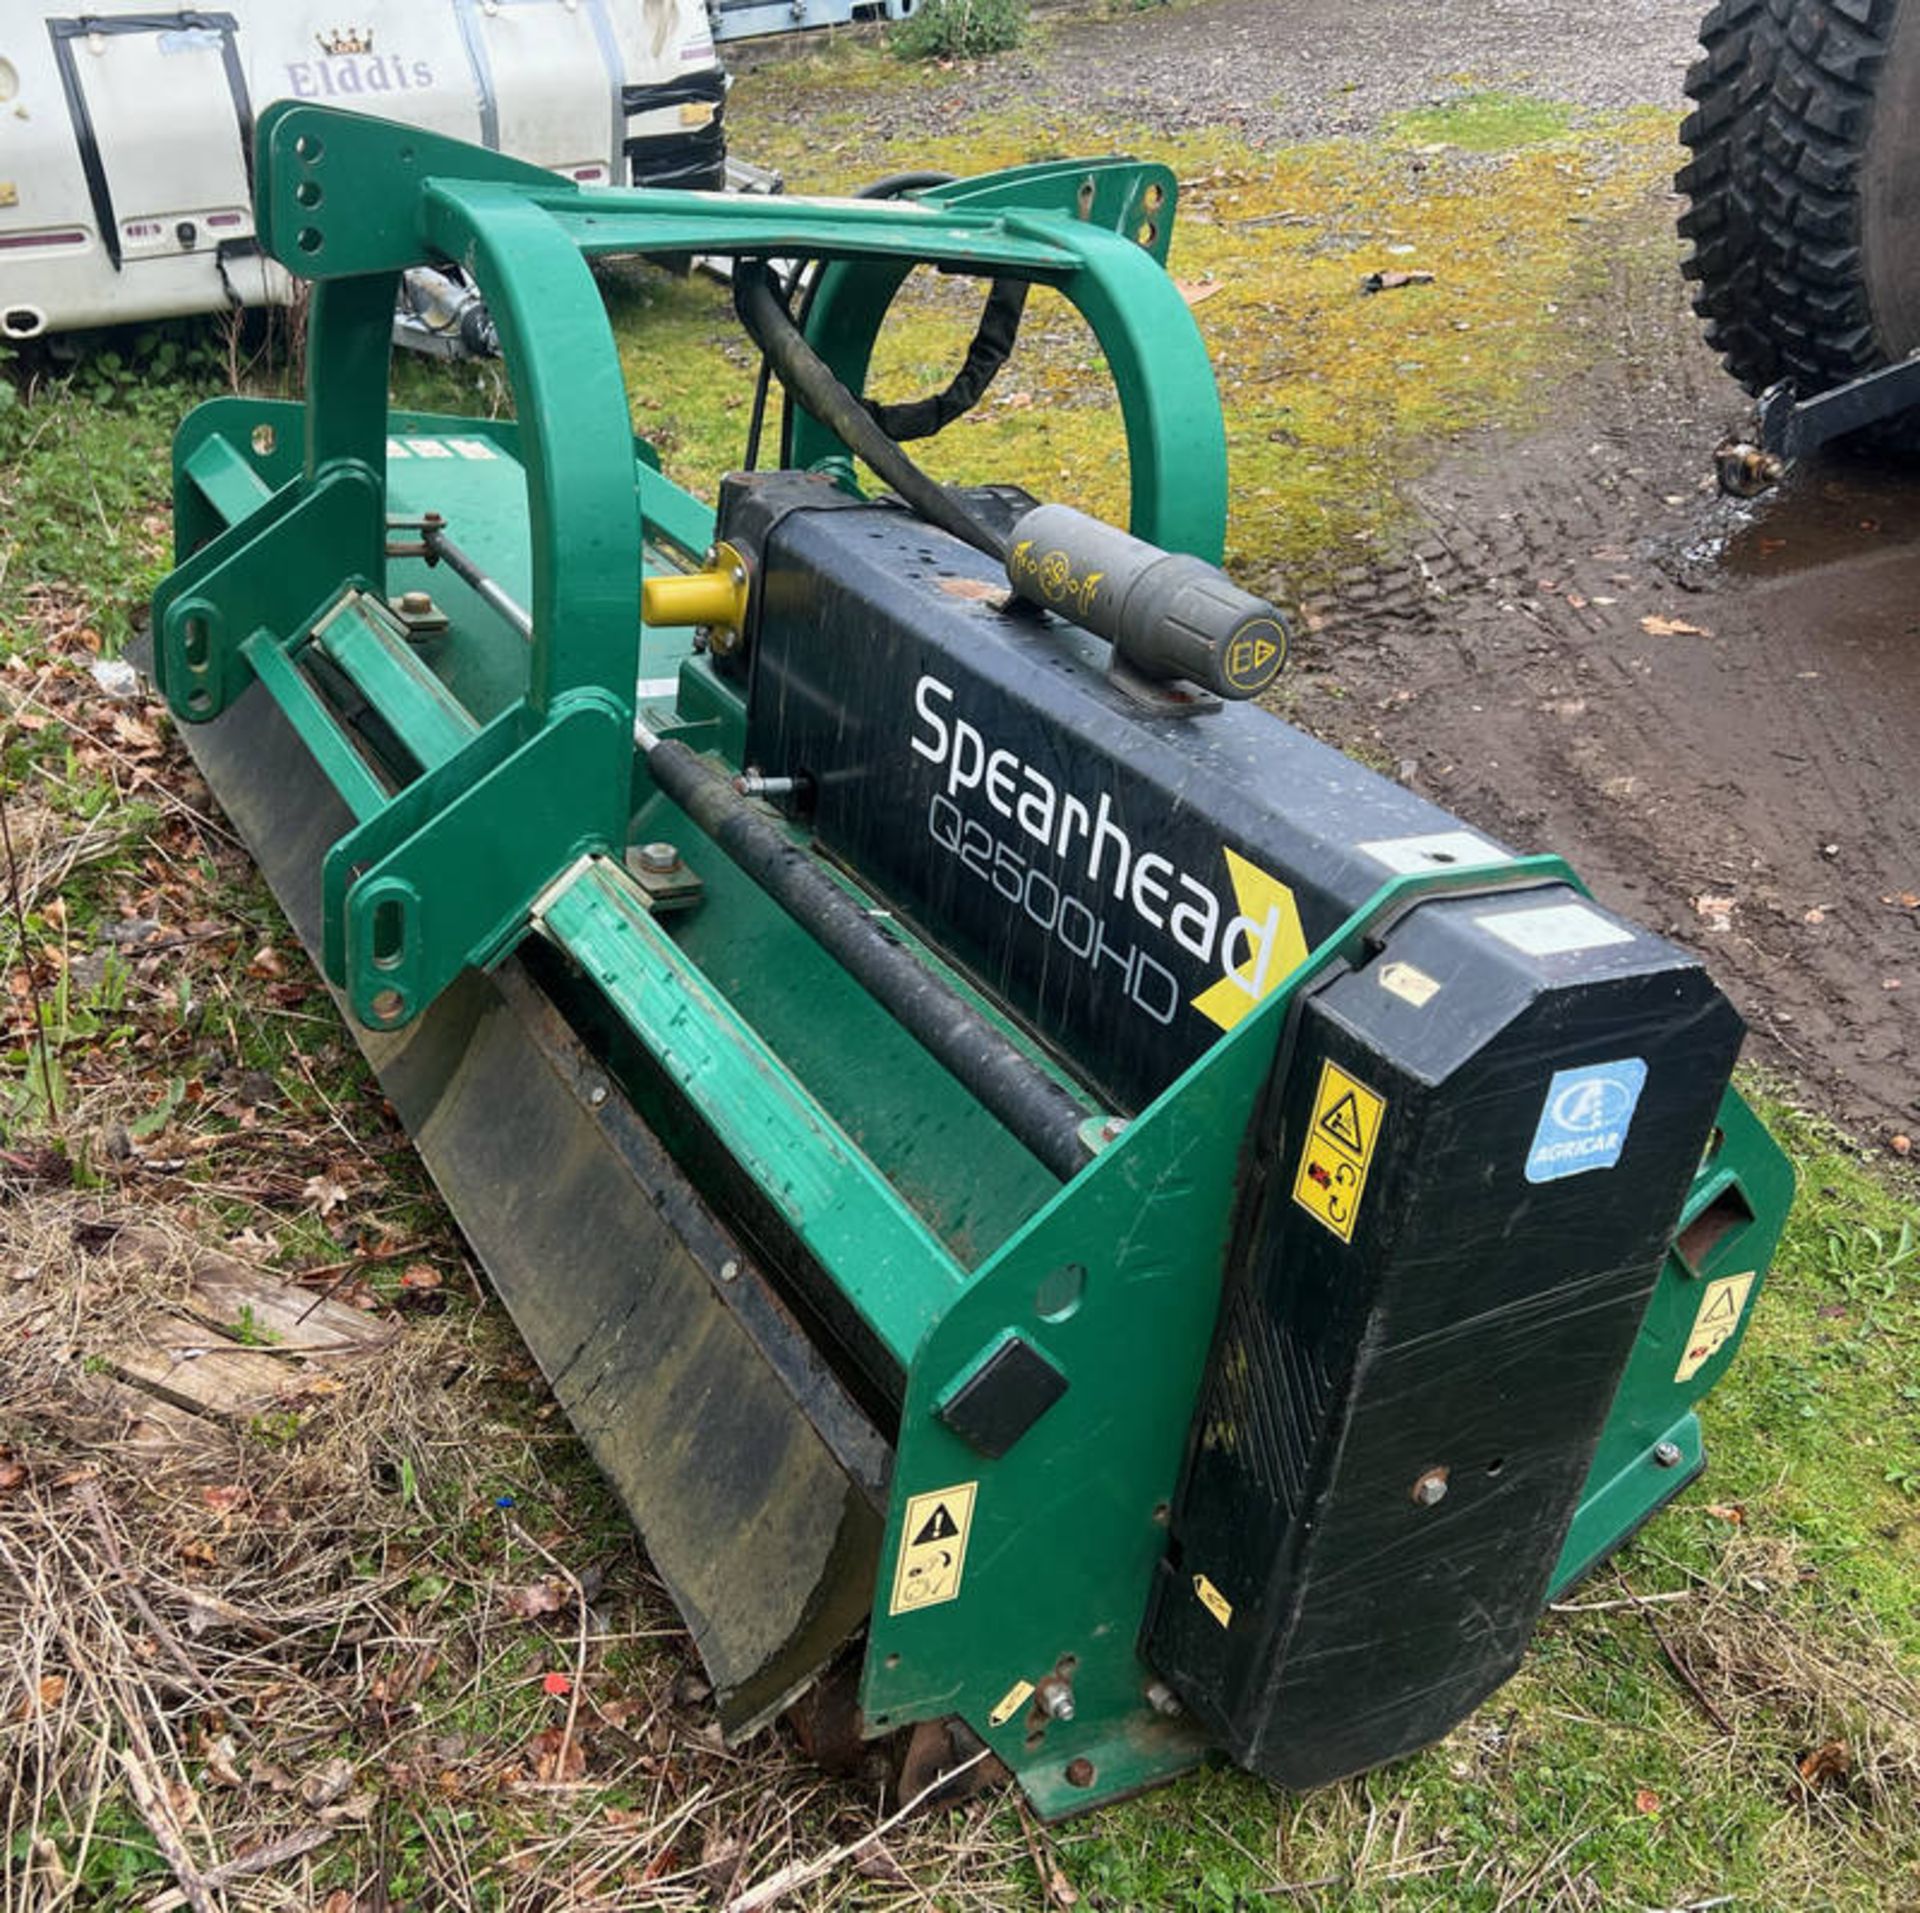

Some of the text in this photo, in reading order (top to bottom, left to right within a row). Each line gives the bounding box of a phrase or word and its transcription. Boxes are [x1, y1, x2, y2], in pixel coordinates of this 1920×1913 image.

[285, 54, 433, 97] Elddis
[911, 675, 1280, 999] Spearhead
[929, 793, 1179, 1024] Q2500HD
